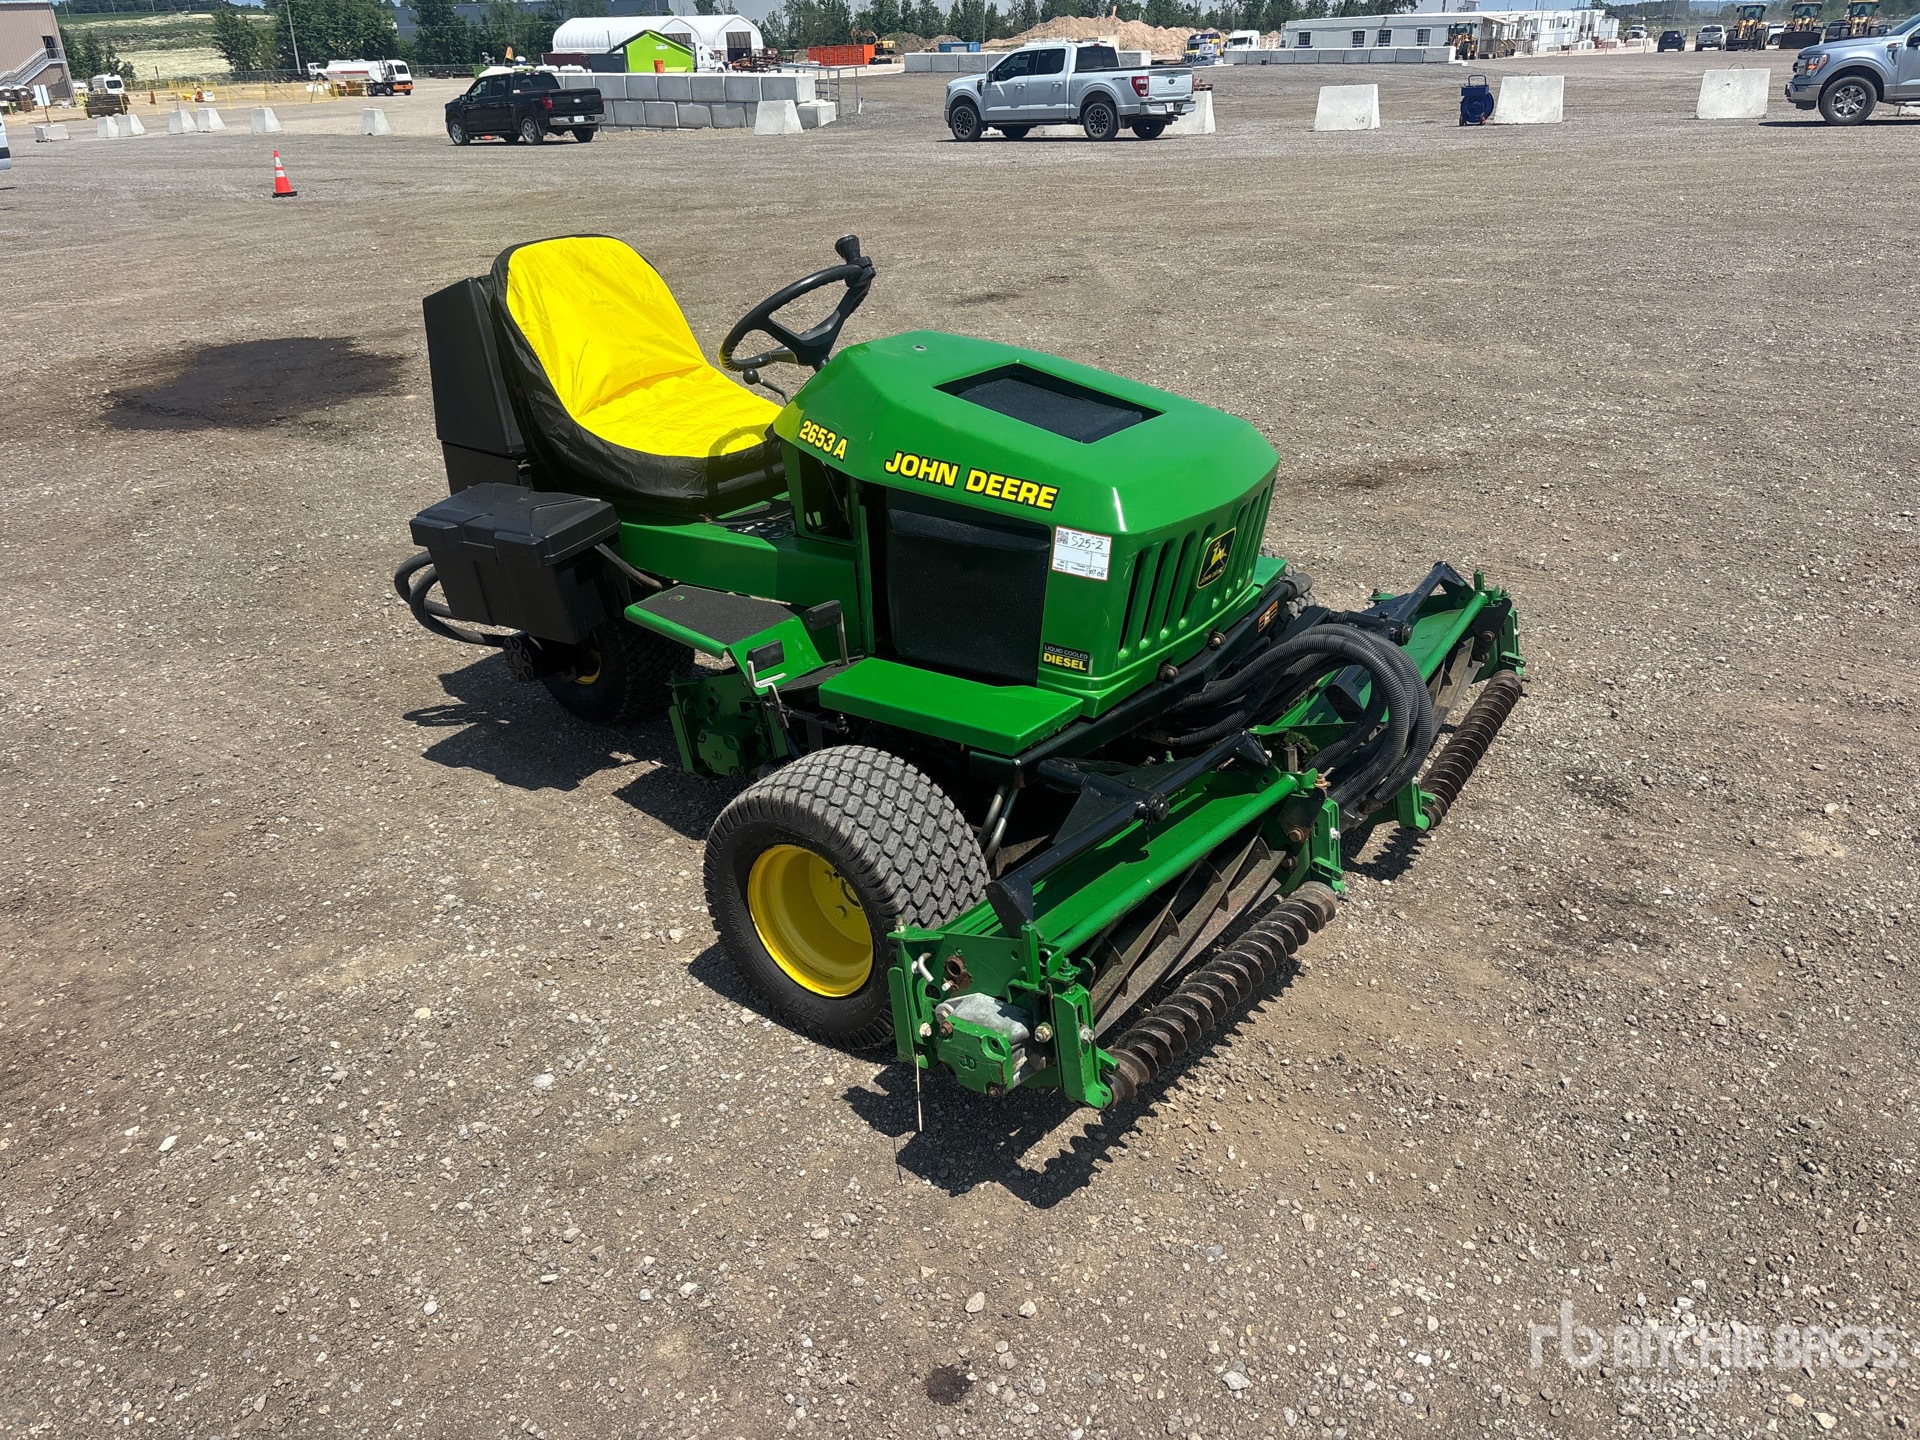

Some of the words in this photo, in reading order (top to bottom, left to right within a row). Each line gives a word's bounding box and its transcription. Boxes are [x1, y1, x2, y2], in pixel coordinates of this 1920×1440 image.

[798, 419, 837, 452] 2653
[832, 438, 848, 460] A
[884, 451, 960, 487] JOHN
[965, 469, 1059, 510] DEERE
[1071, 535, 1104, 551] S25-2
[1043, 652, 1087, 671] DIESEL
[1044, 644, 1064, 654] LIQUID
[1063, 649, 1089, 660] COOLED
